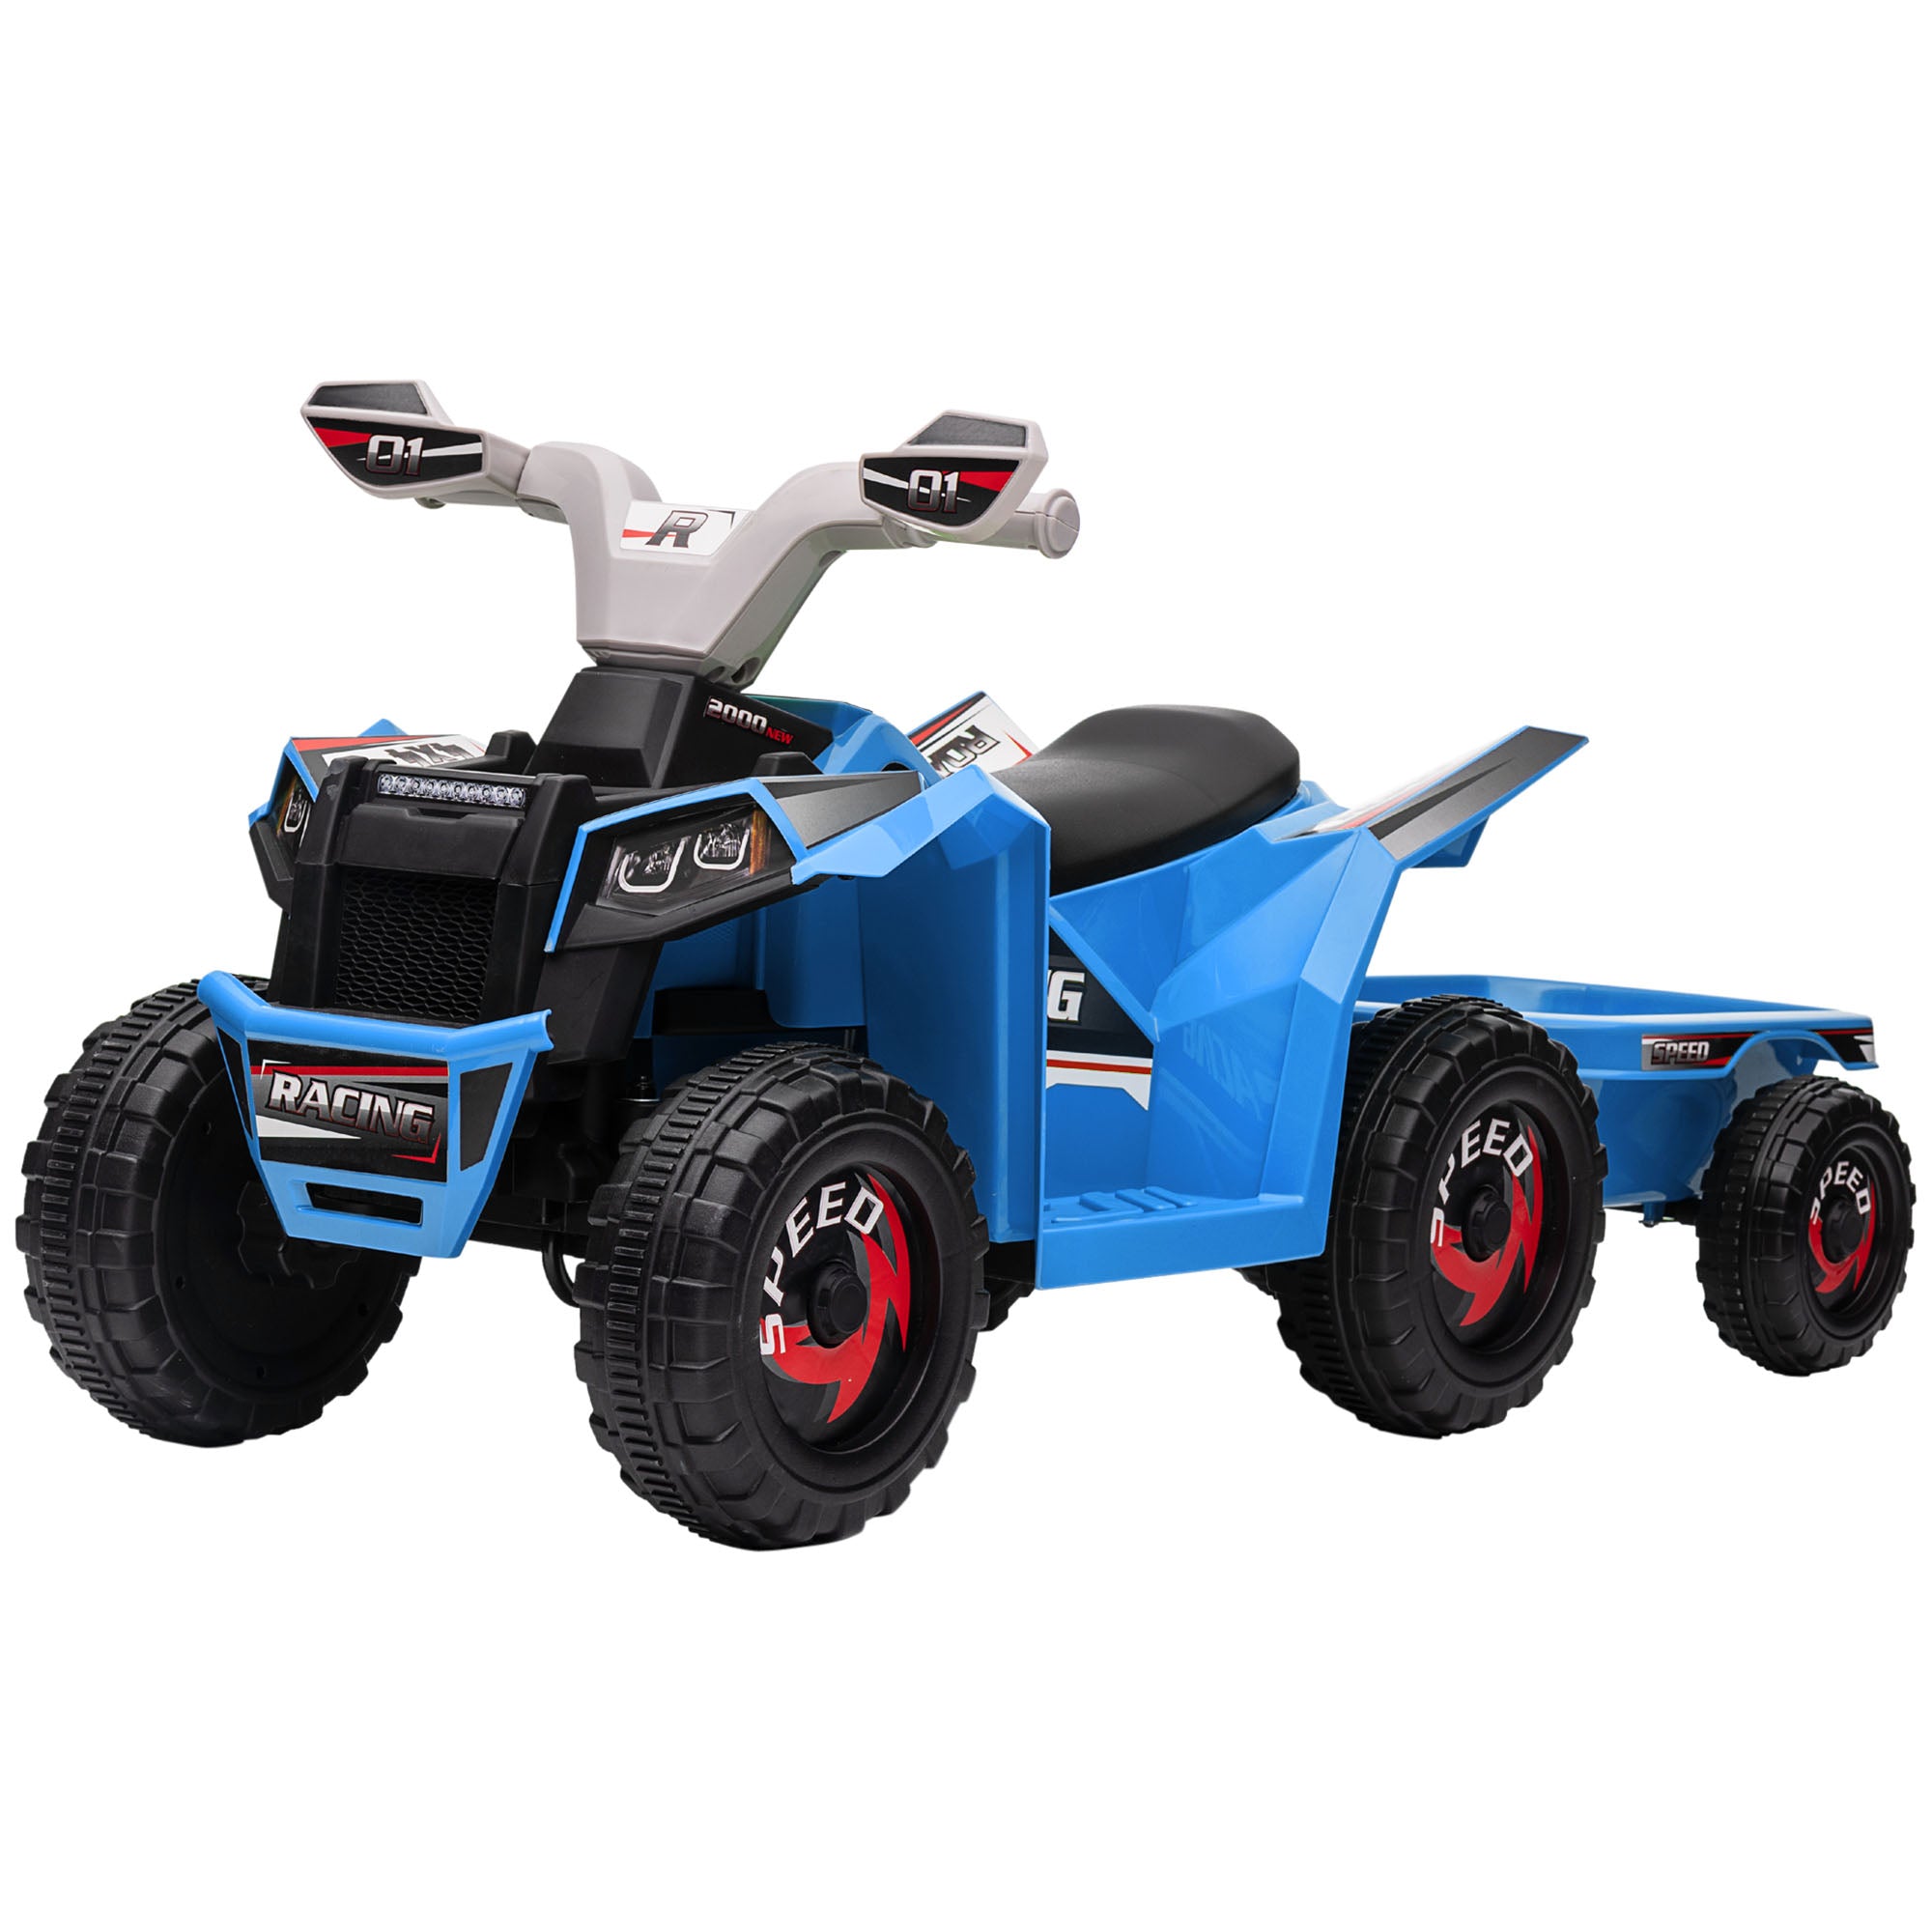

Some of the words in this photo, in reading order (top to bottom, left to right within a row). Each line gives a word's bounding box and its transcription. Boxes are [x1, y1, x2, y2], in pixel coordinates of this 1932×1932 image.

[365, 435, 425, 476] 01
[907, 469, 960, 513] 01
[645, 509, 709, 549] R
[706, 697, 768, 734] 2000
[765, 726, 794, 745] NEW
[1651, 1040, 1710, 1065] SPEED
[265, 1068, 436, 1145] RACING
[759, 1181, 885, 1356] SPEED
